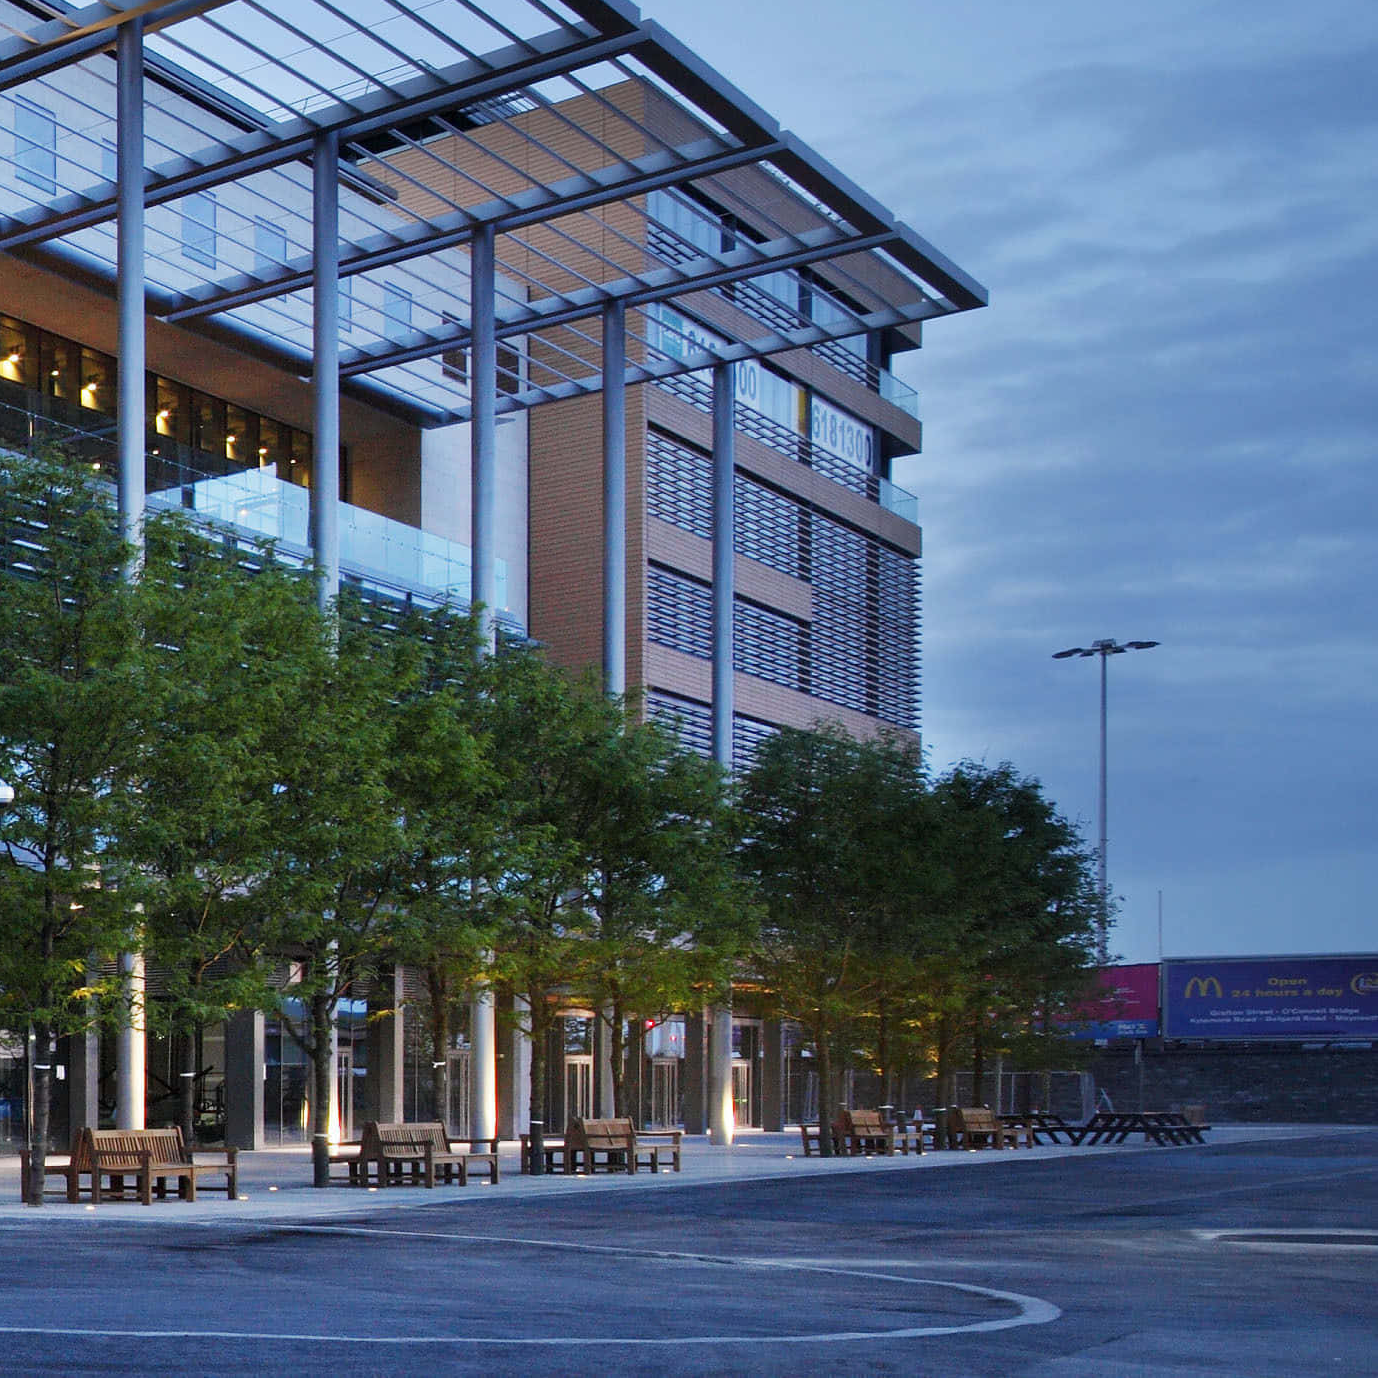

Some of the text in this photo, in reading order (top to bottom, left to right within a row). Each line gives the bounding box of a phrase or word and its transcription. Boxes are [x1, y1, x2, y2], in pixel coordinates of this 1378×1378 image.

[1267, 977, 1308, 987] Open
[1255, 987, 1299, 997] hours
[1317, 987, 1343, 998] day
